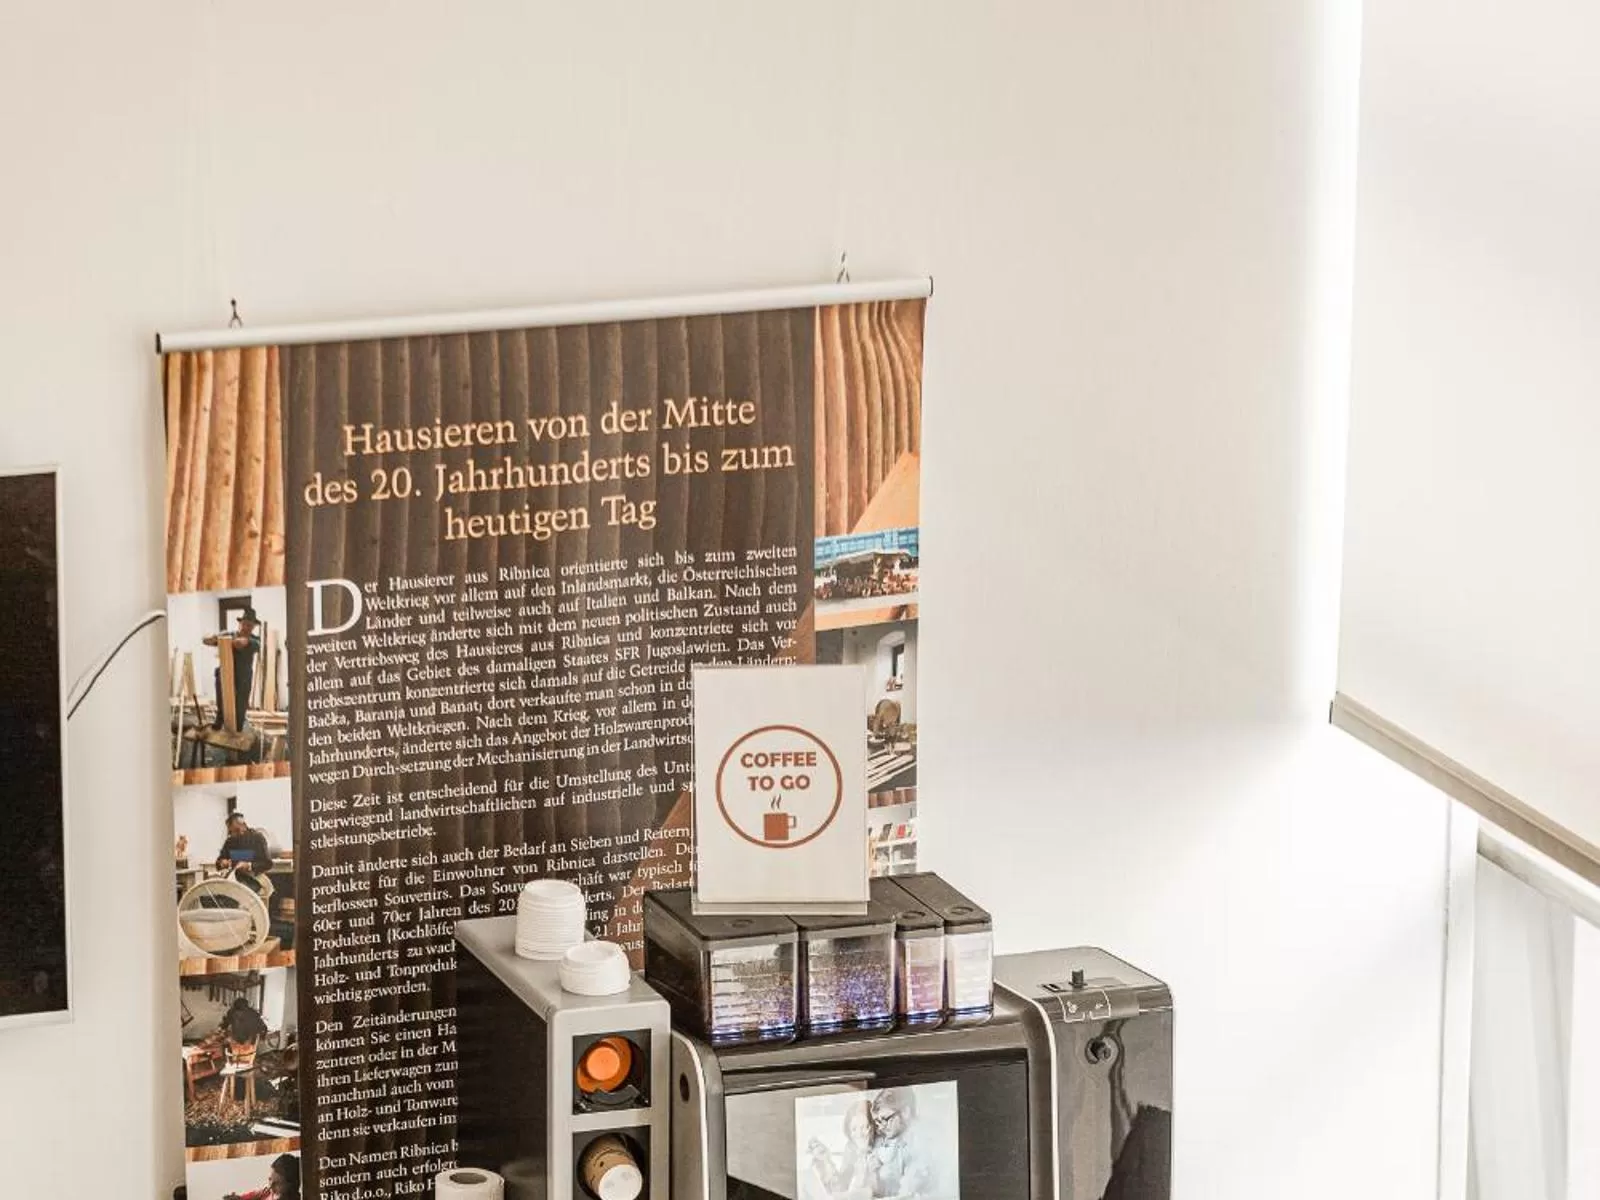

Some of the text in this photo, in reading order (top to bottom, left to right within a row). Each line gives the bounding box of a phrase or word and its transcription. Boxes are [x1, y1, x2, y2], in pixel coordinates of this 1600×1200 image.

[343, 397, 756, 457] Hausieren von der Mitte
[304, 442, 794, 507] des 20. Jahrhunderts bis zum
[444, 495, 657, 542] heutigen Tag
[388, 574, 454, 591] Hausierer
[464, 572, 488, 584] aus
[499, 564, 550, 581] Ribnica
[560, 559, 628, 575] orientierte
[674, 550, 694, 566] bis
[704, 551, 735, 563] zum
[746, 544, 797, 560] zweiten
[364, 593, 429, 612] Weltkrieg
[460, 587, 498, 603] allem
[504, 583, 526, 599] auf
[365, 580, 797, 630] Länder und teilweise auch Italien Balkan. Nach dem
[306, 596, 796, 655] zweiten Weltkrieg änderte mit neuen politischen Zustand auch
[306, 658, 327, 673] der
[530, 640, 554, 652] aus
[561, 632, 610, 649] Ribnica
[741, 617, 768, 633] sich
[306, 675, 343, 692] allem
[376, 669, 400, 684] das
[406, 664, 451, 682] Gebiet
[486, 655, 556, 674] damaligen
[562, 652, 608, 667] Staates
[614, 646, 640, 662] SFR
[647, 641, 730, 663] Jugoslawien.
[737, 637, 764, 652] Das
[405, 681, 494, 701] konzentrierte
[530, 670, 578, 688] damals
[582, 667, 603, 683] auf
[629, 659, 685, 678] Getreide
[355, 707, 405, 724] Baranja
[487, 695, 516, 711] dort
[518, 688, 581, 707] verkaufte
[584, 689, 614, 701] man
[618, 681, 655, 697] schon
[660, 680, 673, 693] in
[337, 726, 381, 744] beiden
[386, 721, 469, 739] Weltkriegen.
[476, 712, 512, 730] Nach
[595, 706, 616, 718] vor
[621, 699, 656, 715] allem
[308, 726, 567, 768] Jahrhunderts, änderte das Angebot
[740, 751, 817, 769] COFFEE
[308, 770, 349, 785] wegen
[476, 746, 585, 766] Mechanisierung
[586, 742, 599, 755] in
[310, 767, 632, 812] Diese Zeit entscheidend für Umstellung
[748, 774, 811, 791] TO GO
[310, 808, 393, 831] überwiegend
[400, 795, 536, 822] landwirtschaftlichen
[543, 790, 565, 807] auf
[311, 861, 354, 878] Damit
[358, 856, 407, 873] änderte
[441, 847, 474, 864] auch
[477, 845, 500, 861] der
[503, 839, 545, 858] Bedarf
[570, 833, 612, 850] Sieben
[311, 845, 666, 899] produkte für Einwohner von Ribnica darstellen.
[384, 888, 452, 906] Souvenirs.
[459, 883, 485, 898] Das
[312, 900, 490, 933] 60er 70er Jahren des
[313, 930, 381, 951] Produkten
[313, 947, 399, 973] Jahrhunderts
[314, 969, 349, 987] Holz-
[314, 979, 430, 1006] wichtig geworden.
[315, 1019, 343, 1034] Den
[370, 1030, 390, 1045] Sie
[394, 1028, 431, 1042] einen
[316, 1046, 414, 1070] zentren oder in
[317, 1064, 431, 1088] ihren Lieferwagen
[317, 1077, 454, 1106] manchmal auch vom
[336, 1098, 400, 1121] Holz- und
[317, 1113, 436, 1142] denn sie verkaufen
[318, 1142, 448, 1170] Den Namen Ribnica
[319, 1161, 407, 1188] sondern auch
[394, 1178, 424, 1195] Riko
